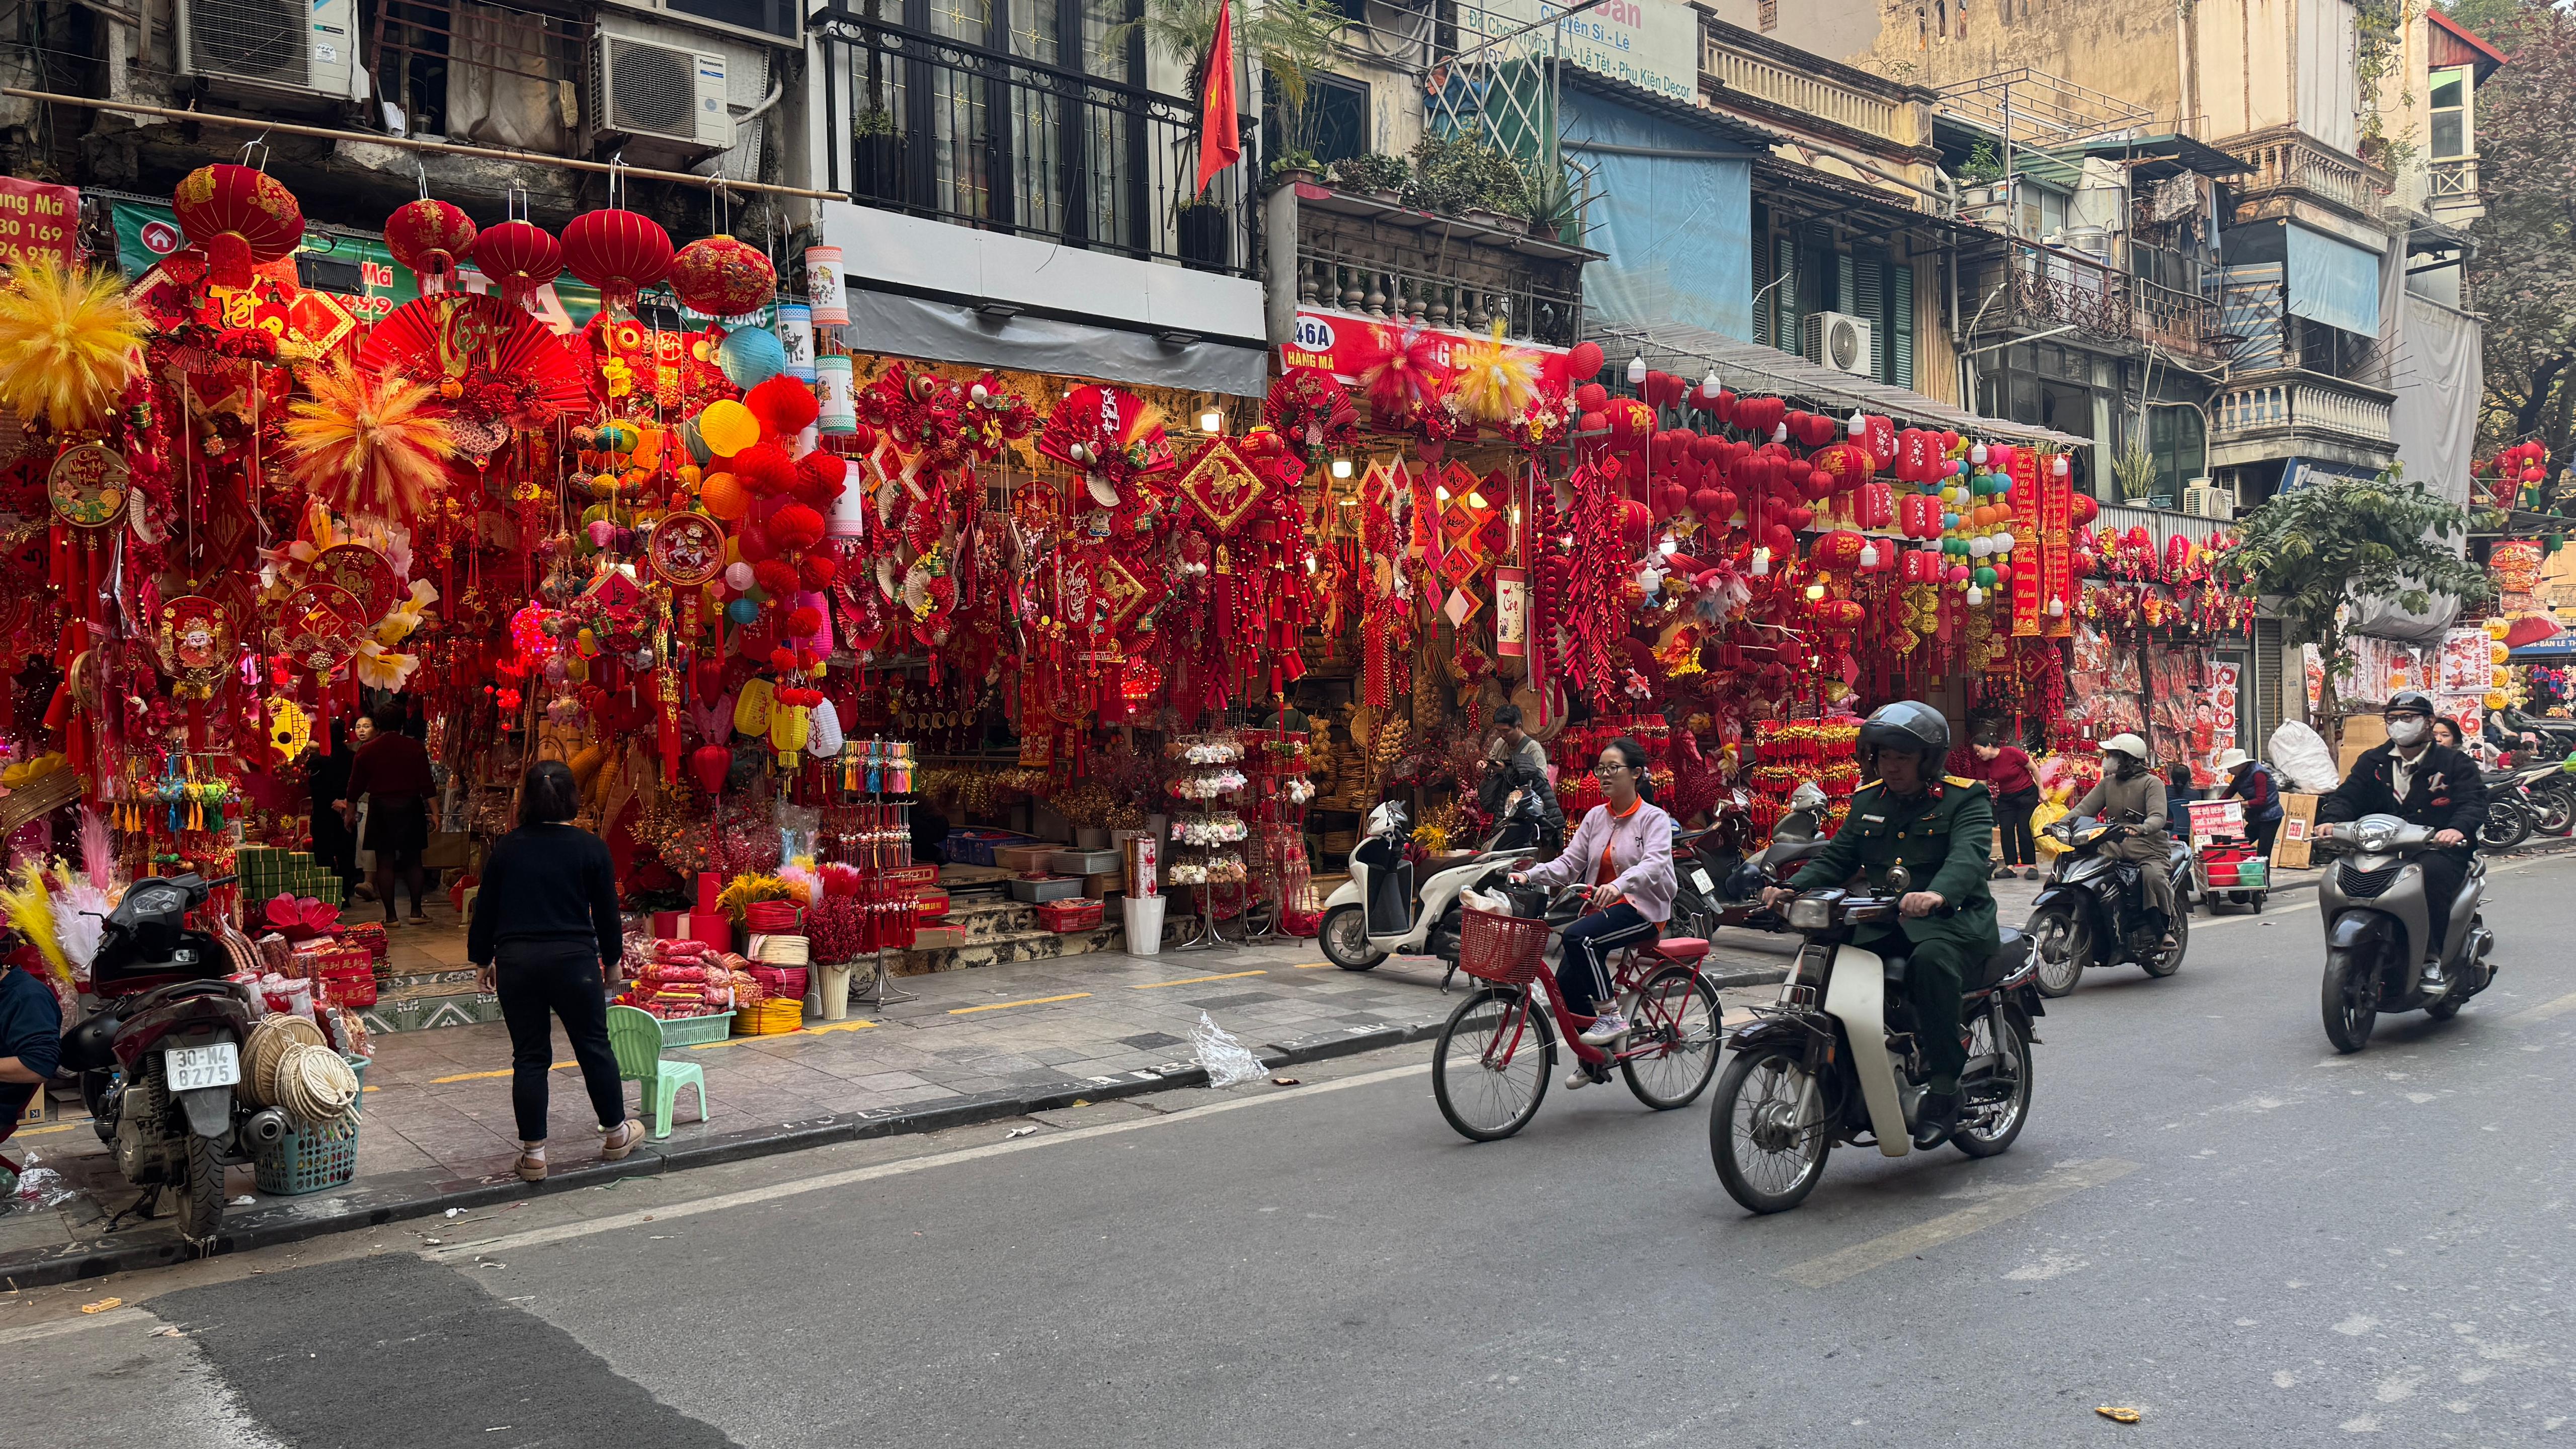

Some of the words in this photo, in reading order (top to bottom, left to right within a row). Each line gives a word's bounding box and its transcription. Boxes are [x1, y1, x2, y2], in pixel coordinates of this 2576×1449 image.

[699, 59, 723, 67] Panasonic
[1551, 38, 1570, 59] hu
[1595, 55, 1611, 74] Tết
[1619, 62, 1638, 86] Phụ
[1640, 67, 1661, 91] Kiện
[1664, 78, 1691, 99] Decor
[0, 194, 28, 216] ng
[35, 193, 63, 216] Mã
[28, 223, 63, 242] 169
[1296, 321, 1330, 347] 46A
[1288, 350, 1317, 368] HÀNG
[1319, 354, 1335, 371] MÃ
[77, 450, 100, 462] Chúc
[1282, 457, 1301, 477] Tết
[77, 474, 99, 489] Mừng
[2015, 571, 2036, 582] Mừng
[1095, 596, 1110, 610] uân
[2016, 589, 2036, 599] Năm
[176, 1046, 228, 1068] 30-M4
[179, 1065, 229, 1087] 8275
